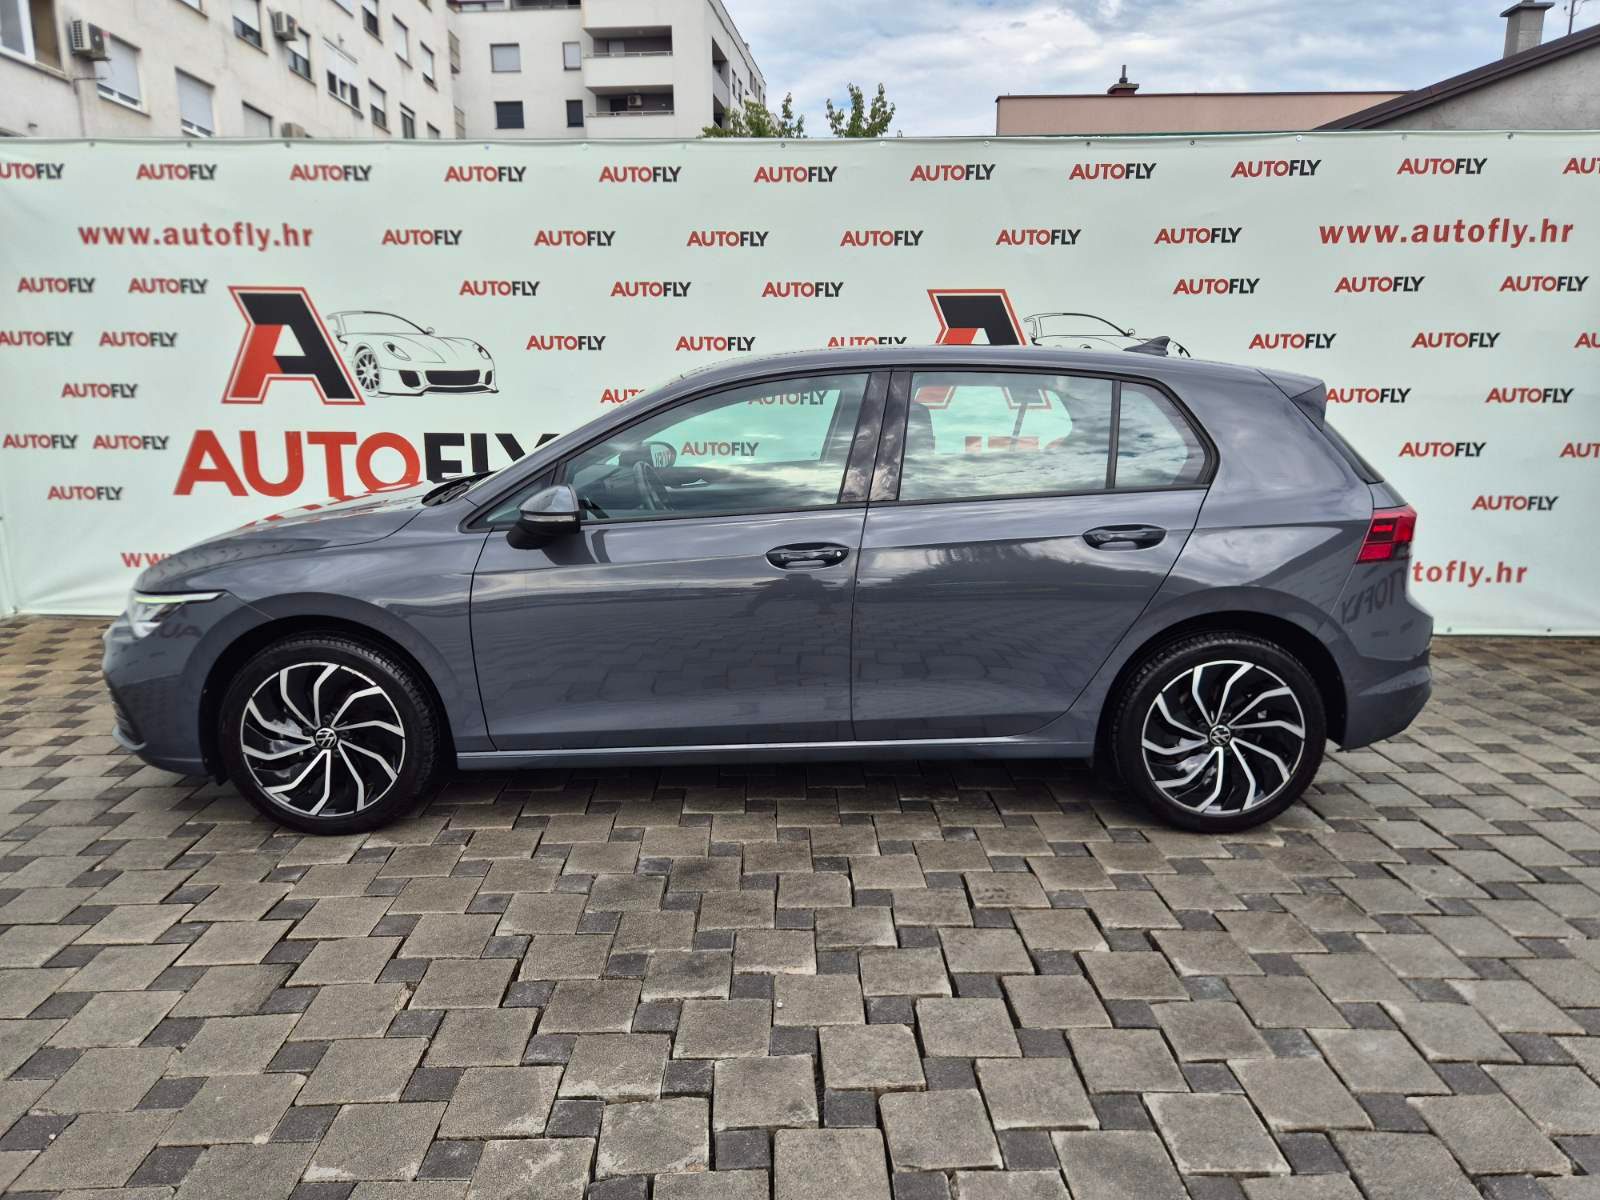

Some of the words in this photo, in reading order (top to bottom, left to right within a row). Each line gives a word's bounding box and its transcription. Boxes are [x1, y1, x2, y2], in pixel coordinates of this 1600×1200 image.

[135, 163, 218, 181] AUTOFLY
[289, 163, 373, 182] AUTOFLY
[443, 165, 527, 183] AUTOFLY
[598, 165, 683, 184] AUTOFLY
[753, 165, 839, 184] AUTOFLY
[909, 163, 997, 182] AUTOFLY
[1068, 162, 1158, 181] AUTOFLY
[1230, 159, 1323, 179] AUTOFLY
[1396, 157, 1488, 176] AUTOFLY
[78, 221, 313, 252] www.autofly.hr
[381, 228, 464, 246] AUTOFLY
[533, 229, 617, 247] AUTOFLY
[686, 230, 770, 248] AUTOFLY
[839, 229, 925, 247] AUTOFLY
[995, 228, 1082, 246] AUTOFLY
[1153, 226, 1243, 245] AUTOFLY
[1319, 217, 1573, 249] www.autofly.hr
[16, 276, 97, 294] AUTOFLY
[127, 277, 209, 295] AUTOFLY
[458, 279, 541, 297] AUTOFLY
[609, 280, 692, 298] AUTOFLY
[761, 281, 845, 298] AUTOFLY
[1172, 277, 1261, 296] AUTOFLY
[1333, 275, 1426, 294] AUTOFLY
[1498, 275, 1590, 293] AUTOFLY
[0, 330, 73, 347] AUTOFLY
[98, 330, 179, 348] AUTOFLY
[525, 334, 607, 352] AUTOFLY
[675, 335, 757, 352] AUTOFLY
[1248, 332, 1337, 350] AUTOFLY
[1410, 331, 1501, 349] AUTOFLY
[60, 382, 139, 399] AUTOFLY
[1325, 387, 1412, 404] AUTOFLY
[1484, 387, 1575, 404] AUTOFLY
[2, 433, 79, 450] AUTOFLY
[92, 434, 170, 451] AUTOFLY
[681, 441, 760, 457] AUTOFLY
[1397, 441, 1487, 458] AUTOFLY
[47, 485, 124, 502] AUTOFLY
[1470, 494, 1560, 512] AUTOFLY
